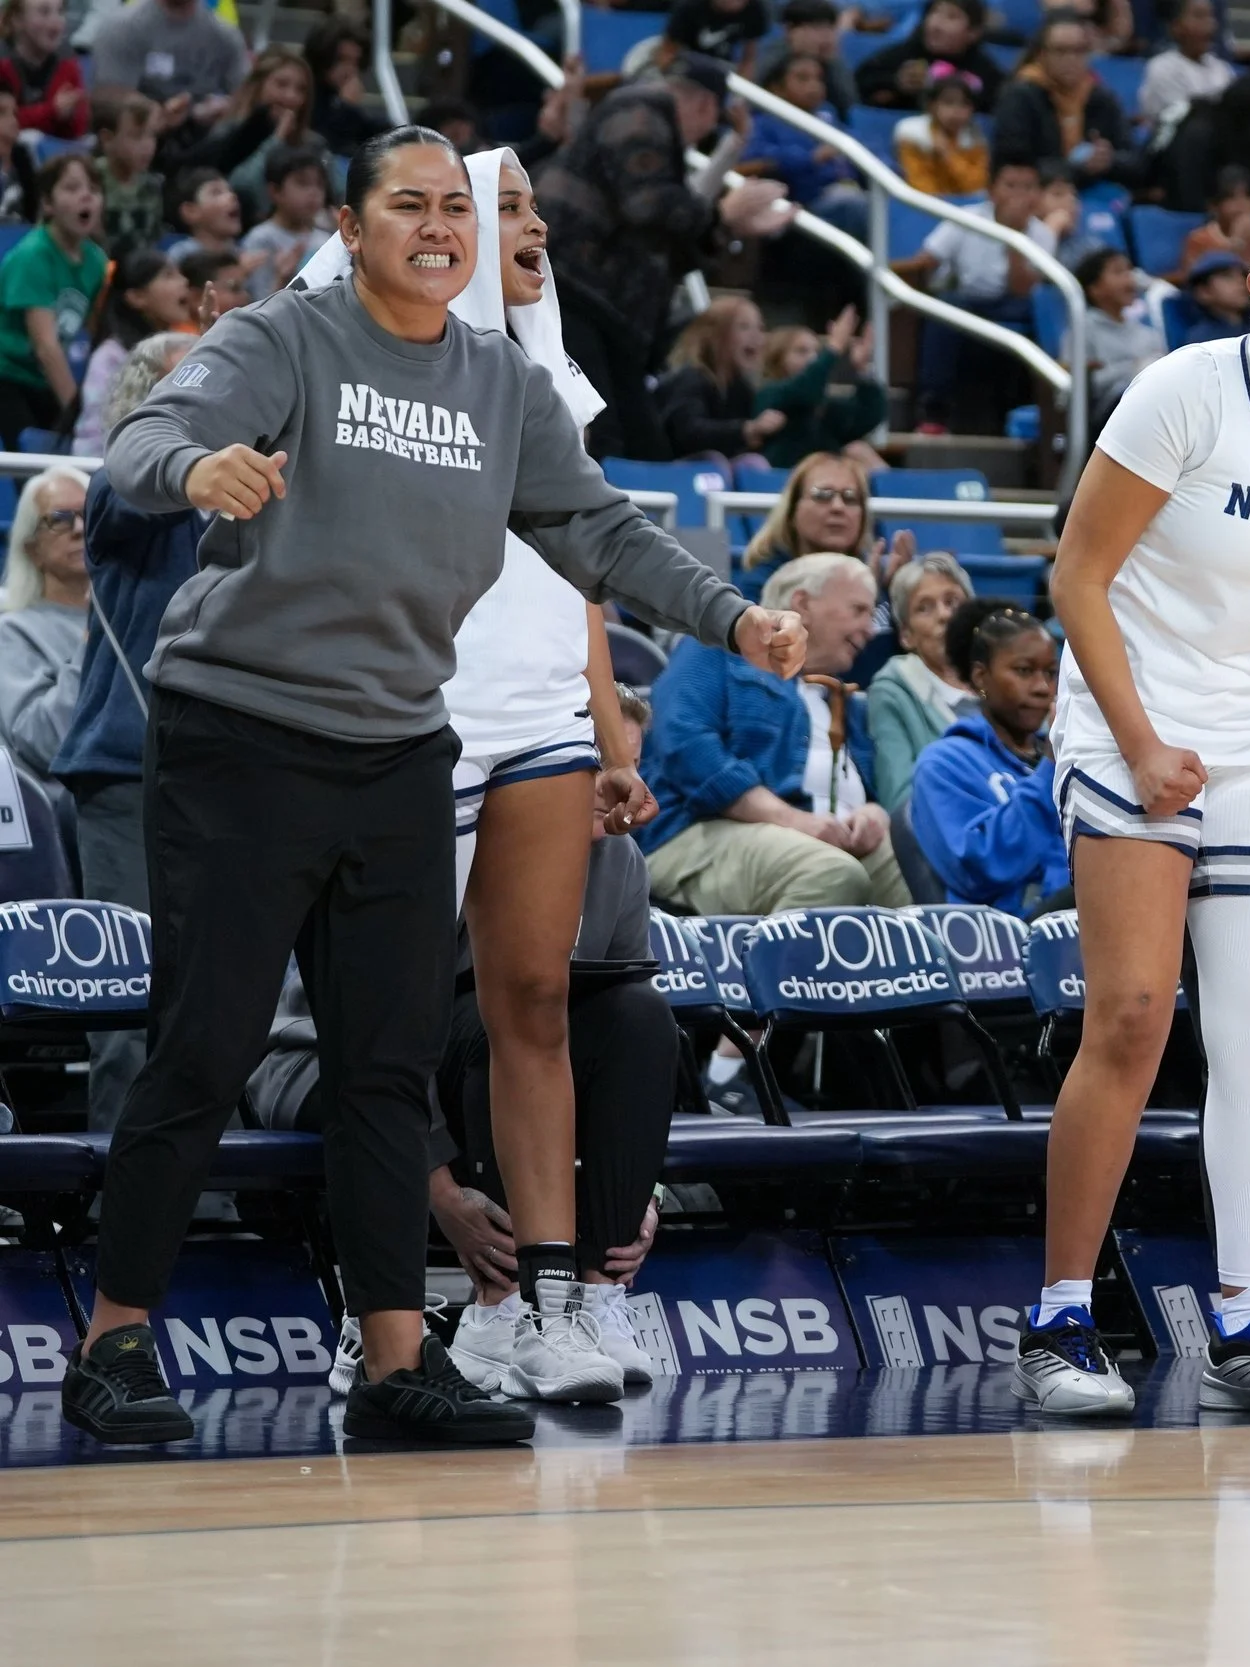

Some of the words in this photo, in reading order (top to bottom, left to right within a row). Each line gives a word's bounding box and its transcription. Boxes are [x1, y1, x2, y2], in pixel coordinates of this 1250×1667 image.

[337, 383, 481, 447] NEVADA
[335, 422, 482, 472] BASKETBALL
[46, 907, 151, 967] JOIN
[815, 913, 933, 971] JOINT
[8, 969, 151, 1002] chiropract
[779, 969, 950, 1003] chiropractic
[164, 1316, 333, 1376] NSB
[676, 1298, 839, 1356] NSB
[923, 1305, 1031, 1363] NS
